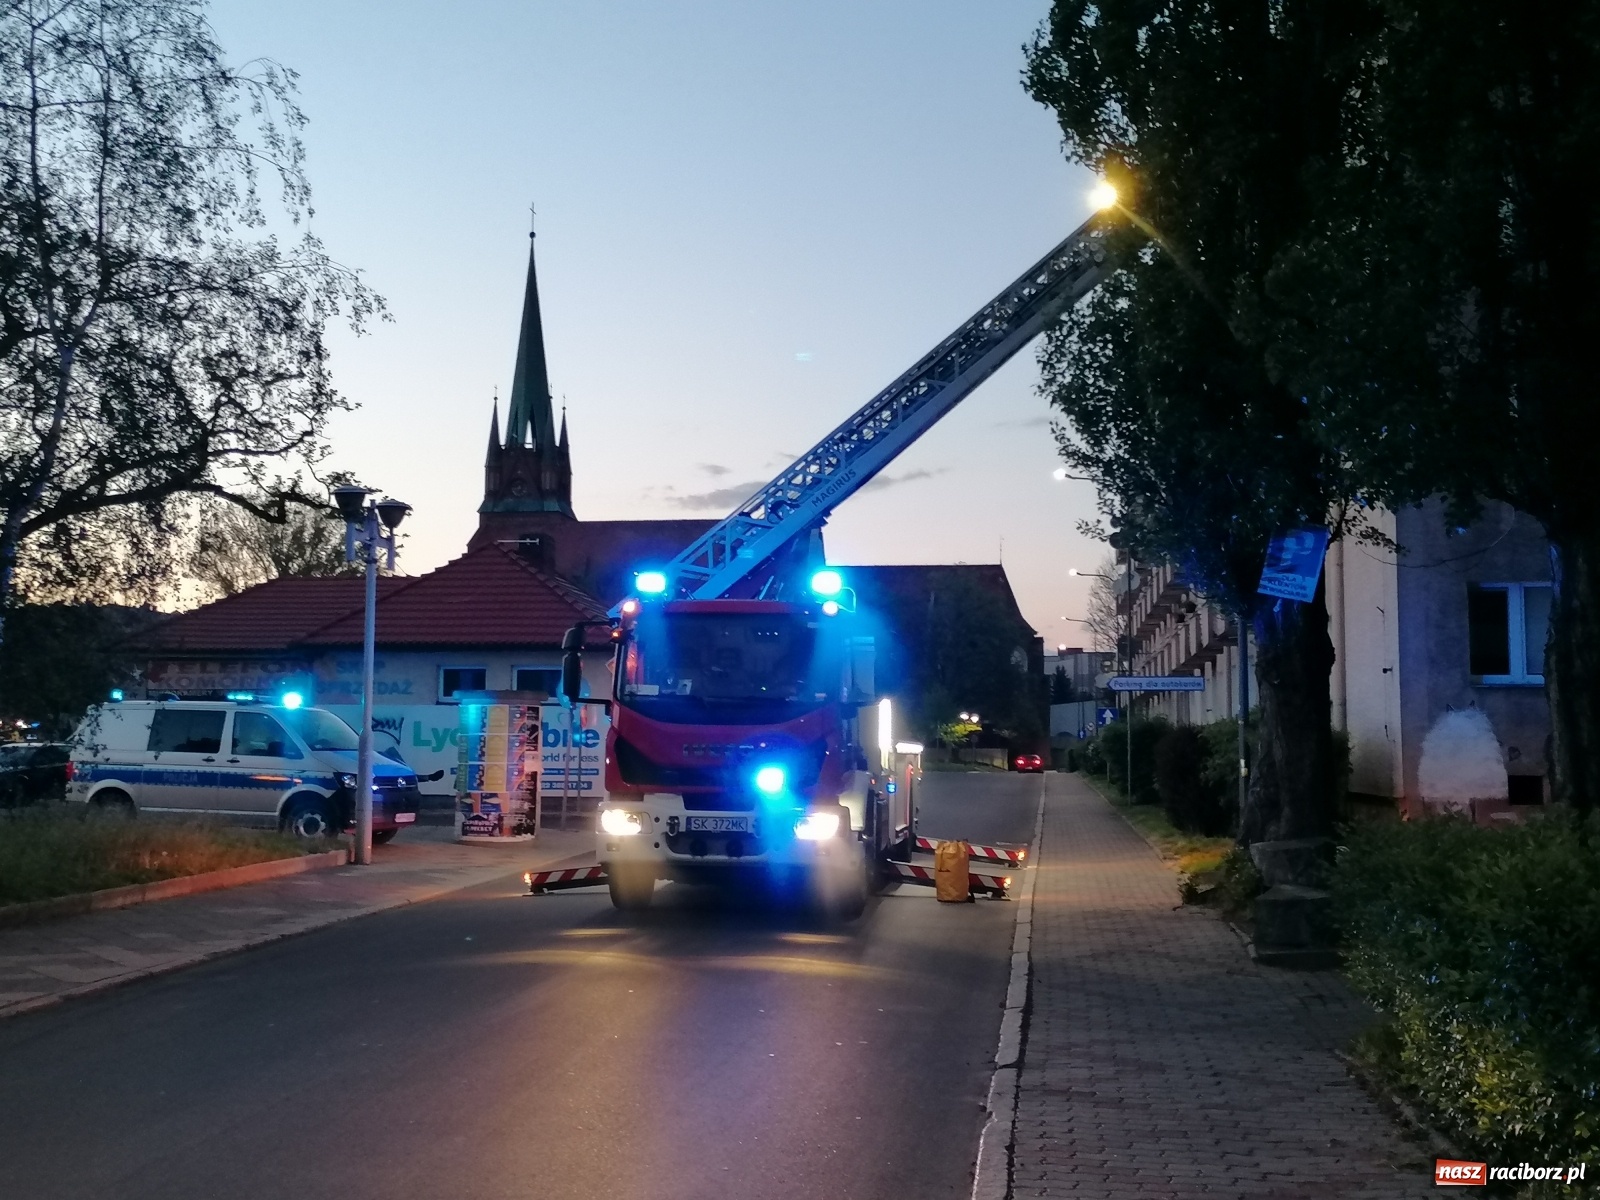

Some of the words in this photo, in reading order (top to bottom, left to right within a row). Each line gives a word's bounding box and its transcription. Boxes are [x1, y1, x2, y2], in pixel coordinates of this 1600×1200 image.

[811, 469, 857, 507] MAGIRUS
[1113, 680, 1143, 688] Parking
[693, 820, 708, 830] SK
[712, 820, 745, 830] 372MK
